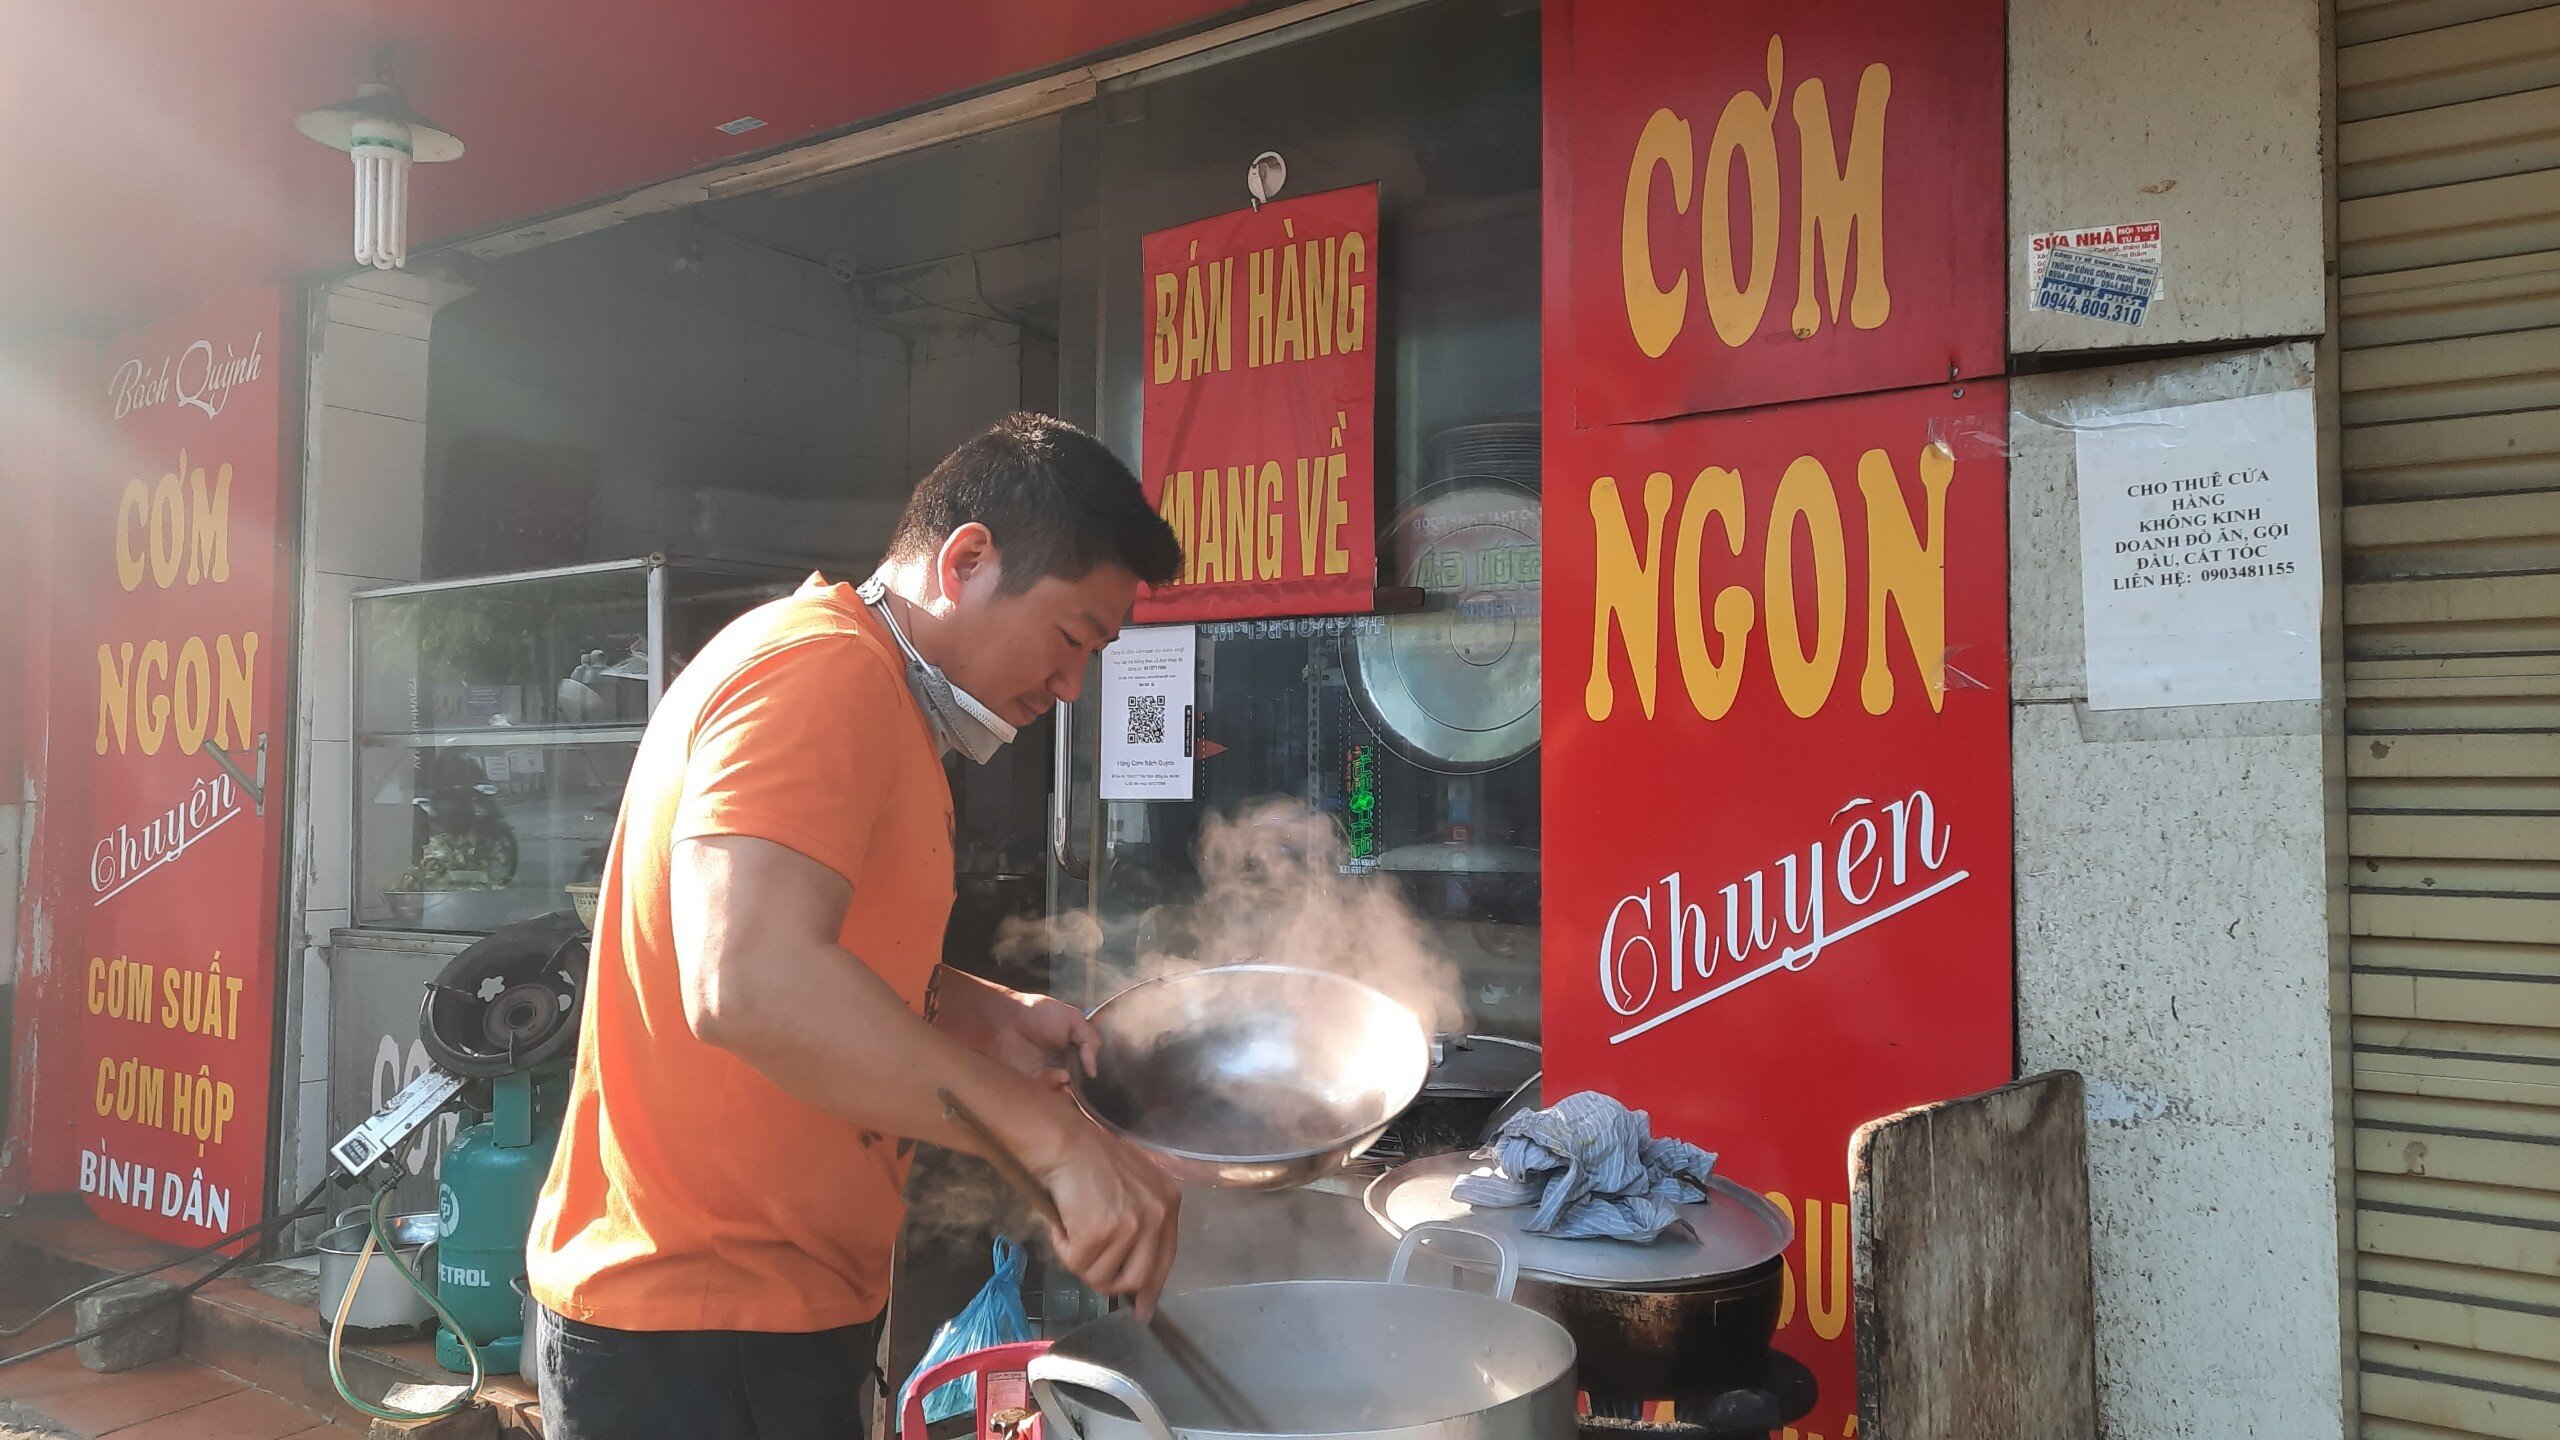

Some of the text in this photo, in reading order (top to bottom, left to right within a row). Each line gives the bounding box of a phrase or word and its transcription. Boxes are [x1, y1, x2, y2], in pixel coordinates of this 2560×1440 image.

[1621, 33, 1891, 358] CƠM
[1154, 218, 1366, 385] BÁN HÀNG
[2040, 291, 2141, 325] 0944.809.310
[108, 331, 262, 419] Bách Quỳnh
[116, 448, 232, 591] CƠM
[1159, 411, 1349, 585] MANG VỀ
[2127, 468, 2270, 498] CHO THUÊ CỬA
[2139, 507, 2261, 533] KHÔNG KINH
[2171, 493, 2226, 512] HÀNG
[1585, 442, 1955, 721] NGON
[2113, 572, 2155, 591] LIÊN
[2200, 561, 2295, 582] 0903481155
[2115, 535, 2180, 554] DOANH
[2226, 543, 2268, 560] TÓC
[96, 632, 258, 755] NGON
[90, 777, 237, 894] Chuyên
[1599, 790, 1950, 1016] Chuyên
[87, 951, 243, 1041] CƠM SUẤT
[95, 1056, 235, 1158] CƠM HỘP
[79, 1137, 230, 1235] BÌNH DÂN
[439, 1264, 491, 1287] ETROL
